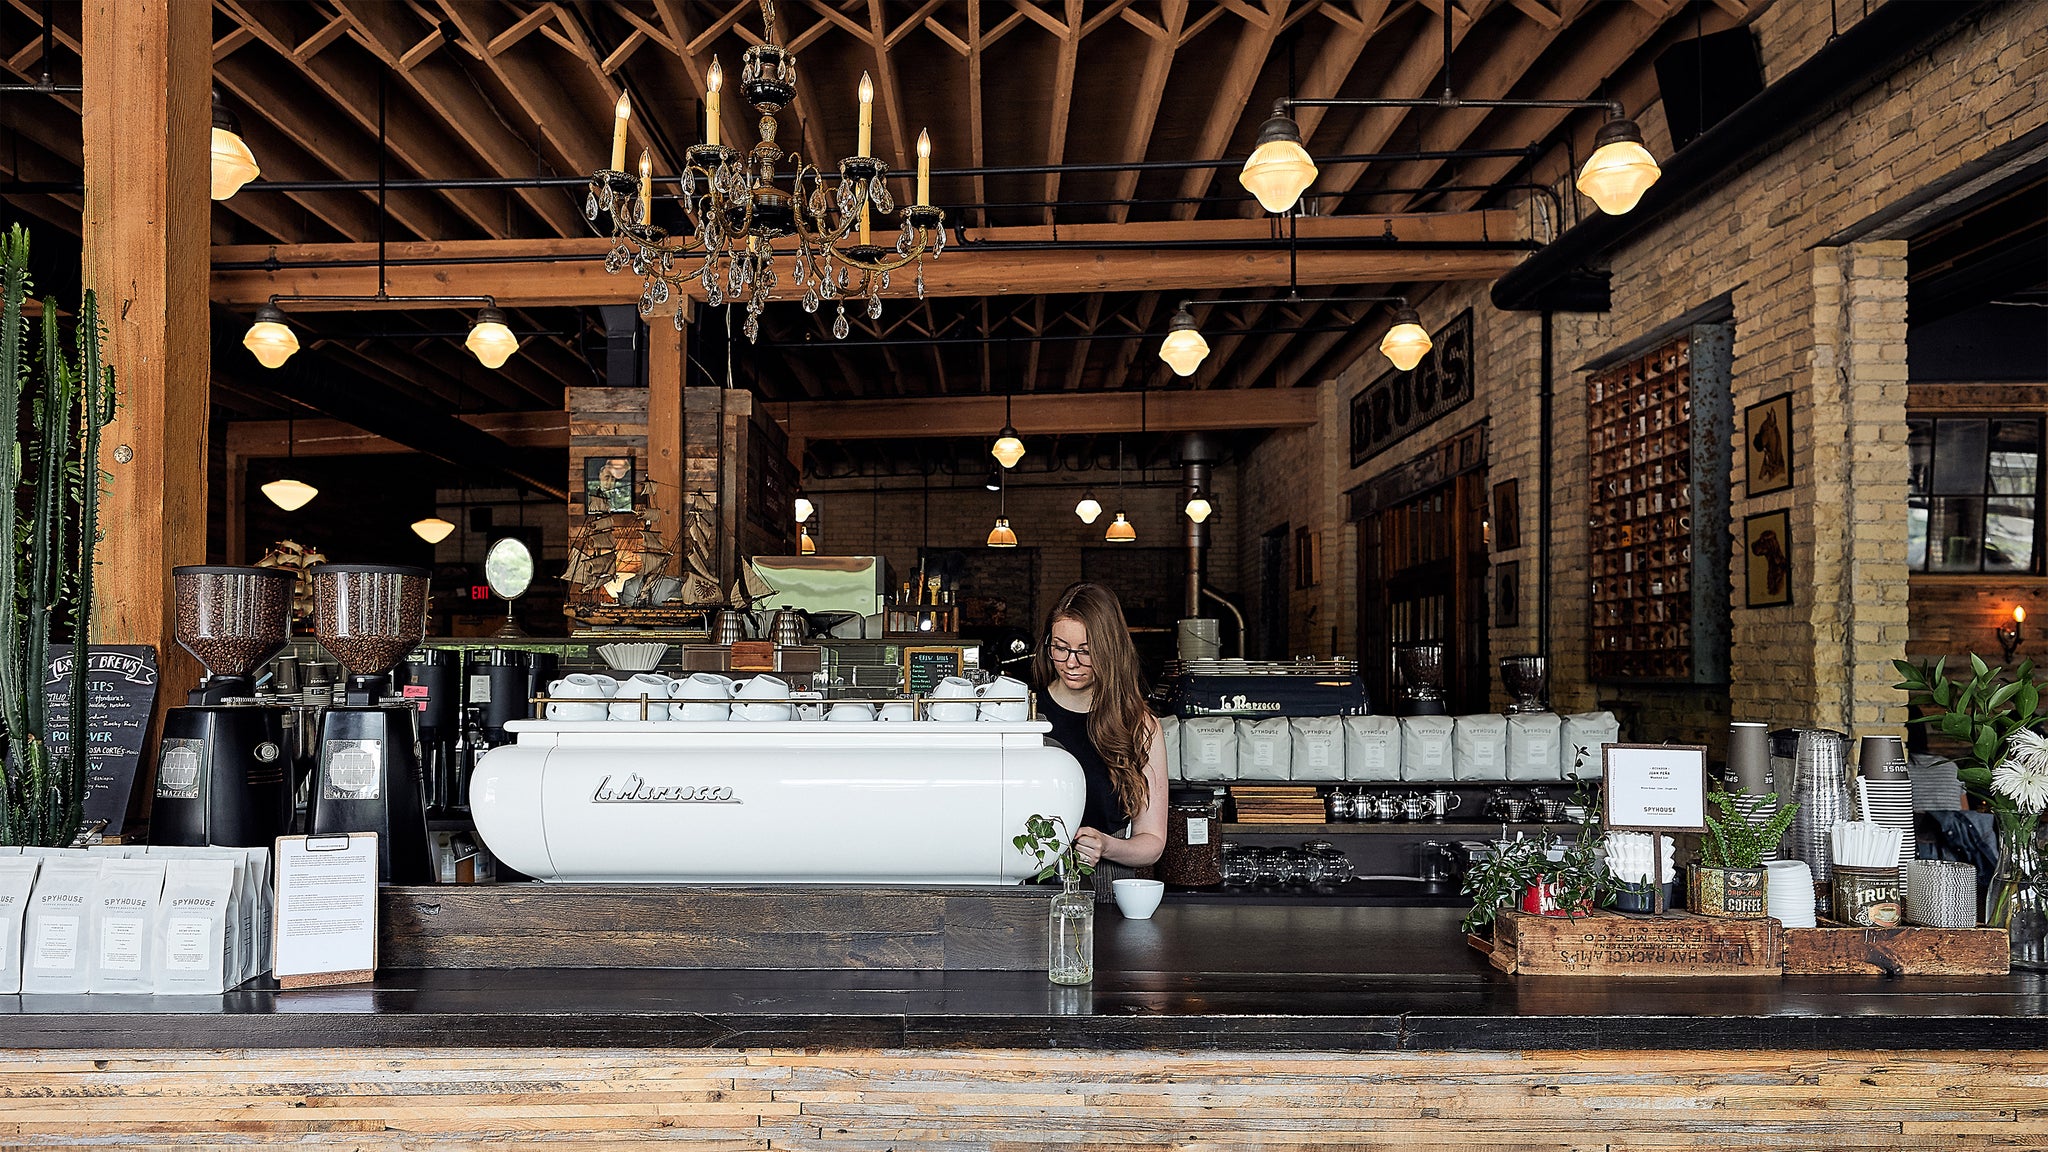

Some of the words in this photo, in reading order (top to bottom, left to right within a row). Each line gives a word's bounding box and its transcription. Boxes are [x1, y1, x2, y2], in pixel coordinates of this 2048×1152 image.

[1355, 329, 1465, 454] DRUGS
[471, 585, 489, 600] EXIT
[56, 655, 96, 672] DAY
[99, 655, 140, 674] BREWS
[1220, 695, 1231, 710] La
[1232, 694, 1281, 711] Marzocco
[590, 774, 613, 801] La
[614, 772, 735, 801] Marzocco
[41, 894, 84, 904] SPYHOUSE
[104, 898, 147, 907] SPYHOUSE
[172, 898, 216, 907] SPYHOUSE
[1728, 898, 1761, 911] COFFEE
[1560, 950, 1623, 964] CLAMPS
[1627, 951, 1665, 964] RACK
[1669, 951, 1698, 964] HAY
